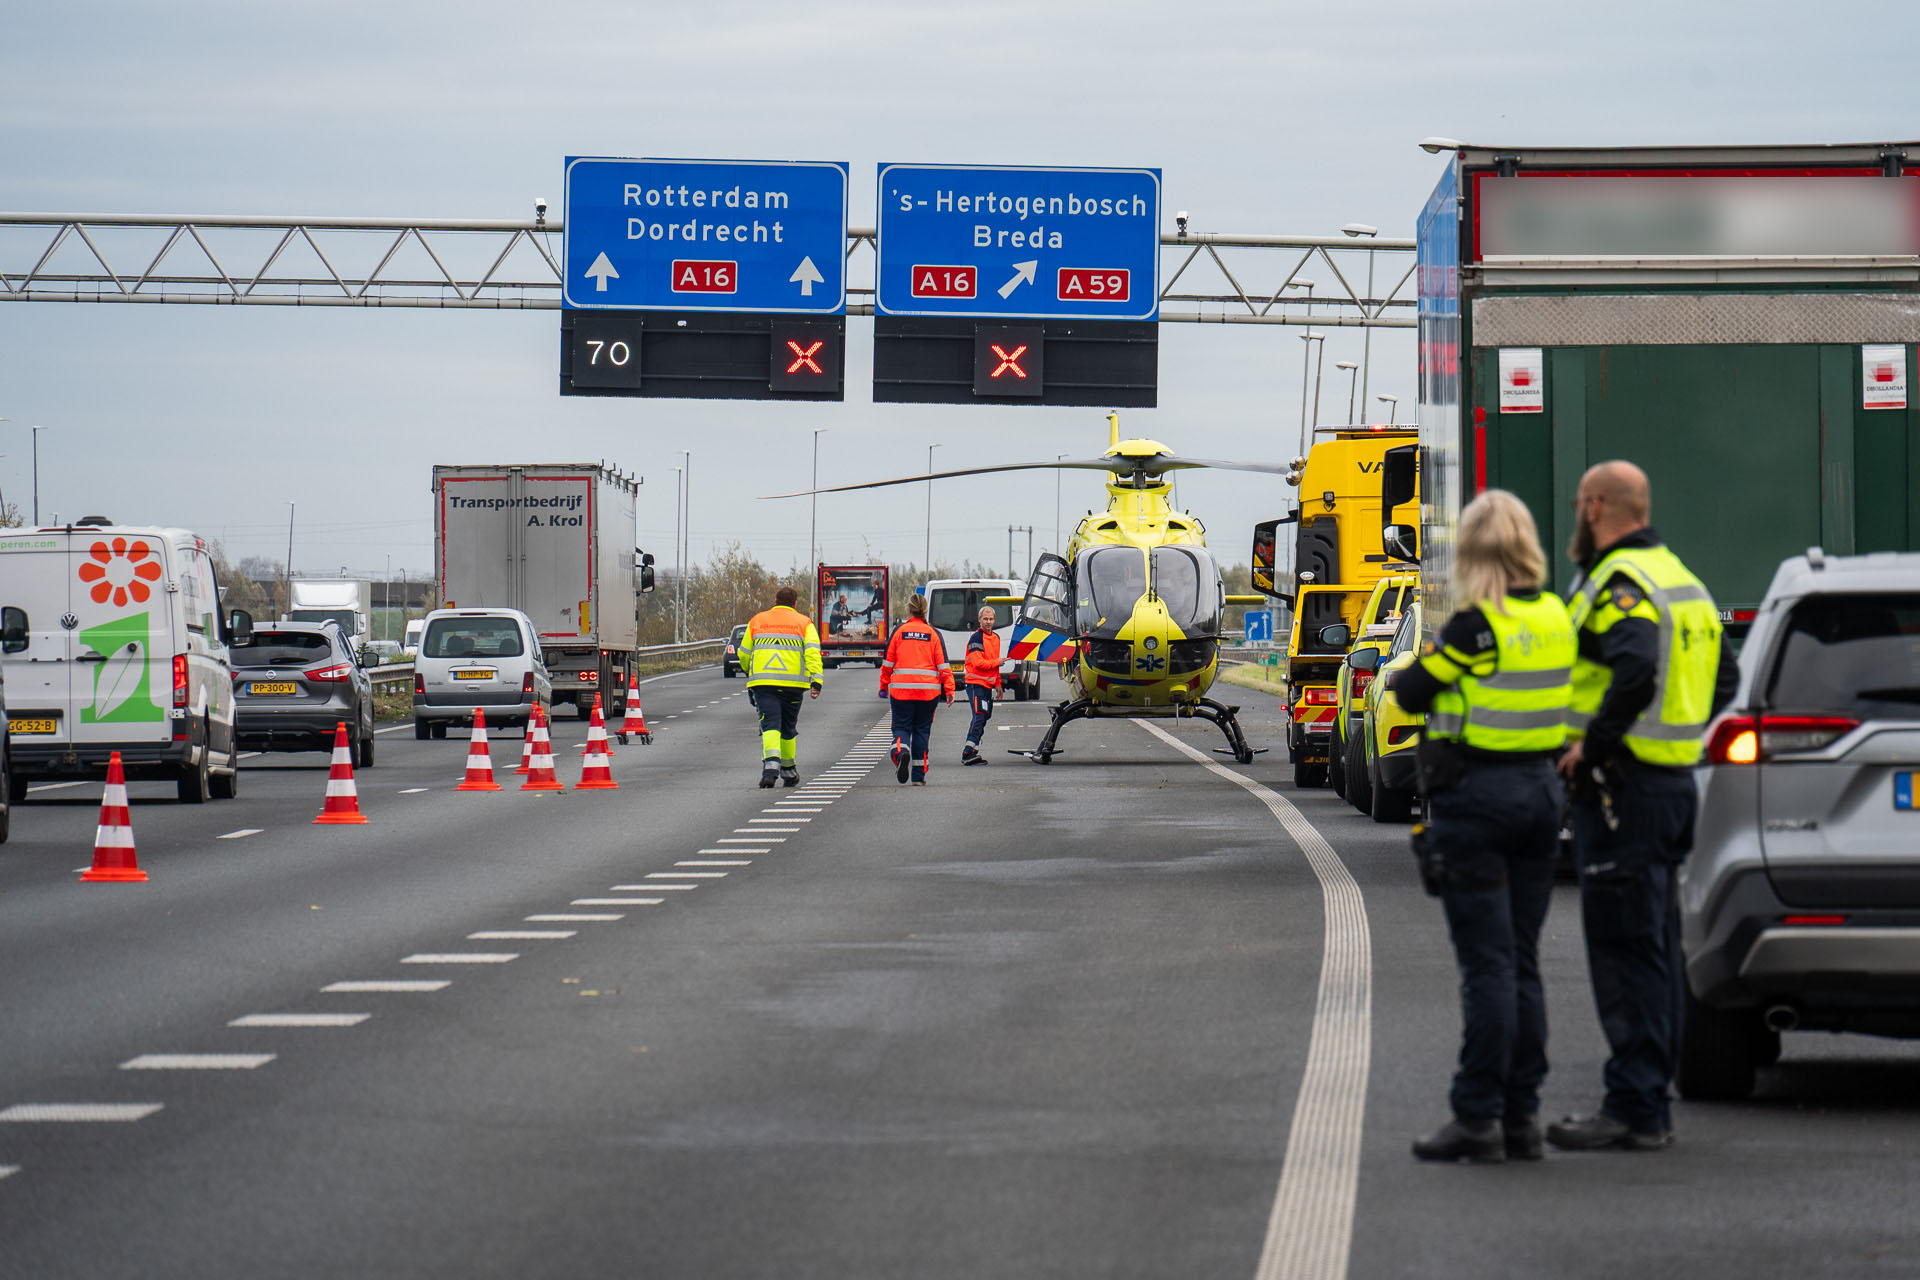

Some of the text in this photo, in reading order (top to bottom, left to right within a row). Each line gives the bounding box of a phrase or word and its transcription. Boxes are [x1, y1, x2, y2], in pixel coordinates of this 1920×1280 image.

[624, 183, 789, 209] Rotterdam
[627, 217, 784, 243] Dordrecht
[973, 225, 1063, 249] Breda
[586, 340, 631, 366] 70
[450, 495, 583, 511] Transportbedrijf
[527, 514, 583, 527] A. Krol
[254, 684, 293, 692] PP-300-V
